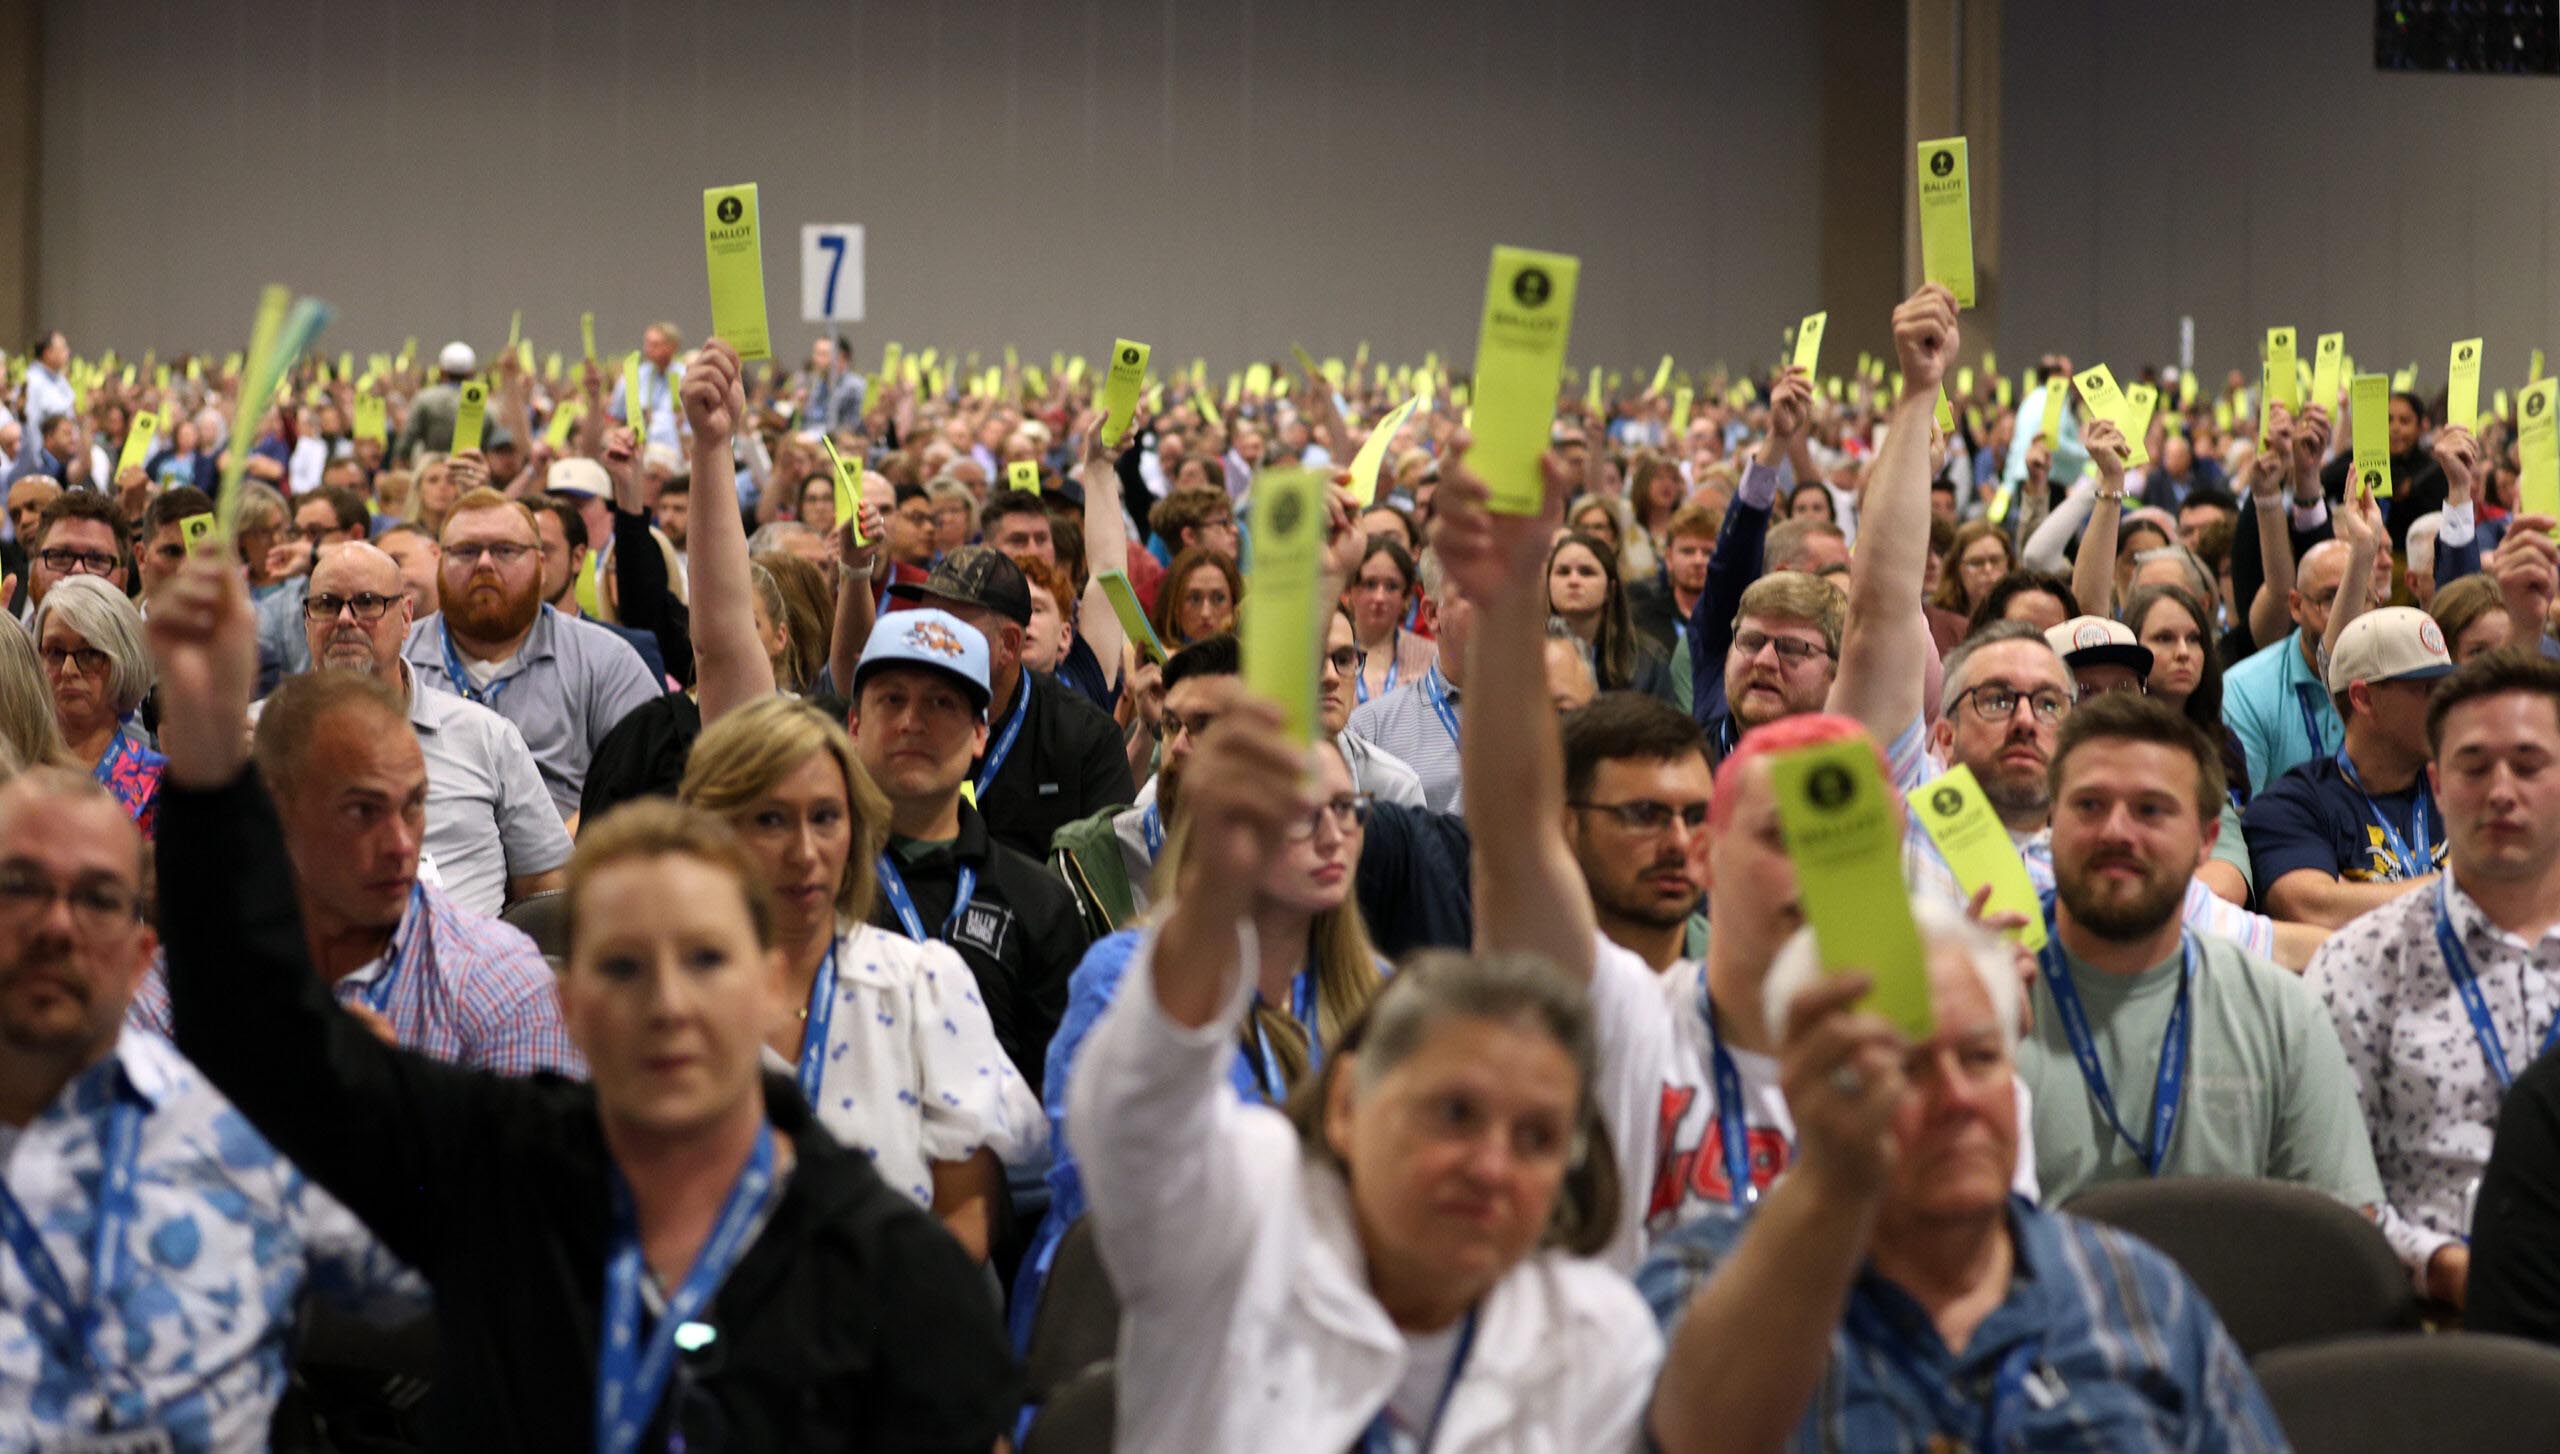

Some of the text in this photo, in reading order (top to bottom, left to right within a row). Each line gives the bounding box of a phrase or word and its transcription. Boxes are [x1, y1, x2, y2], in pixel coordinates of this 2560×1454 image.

[1924, 179, 1961, 194] BALLOT
[710, 227, 752, 241] BALLOT
[818, 235, 847, 317] 7
[2359, 459, 2388, 468] BALLOT
